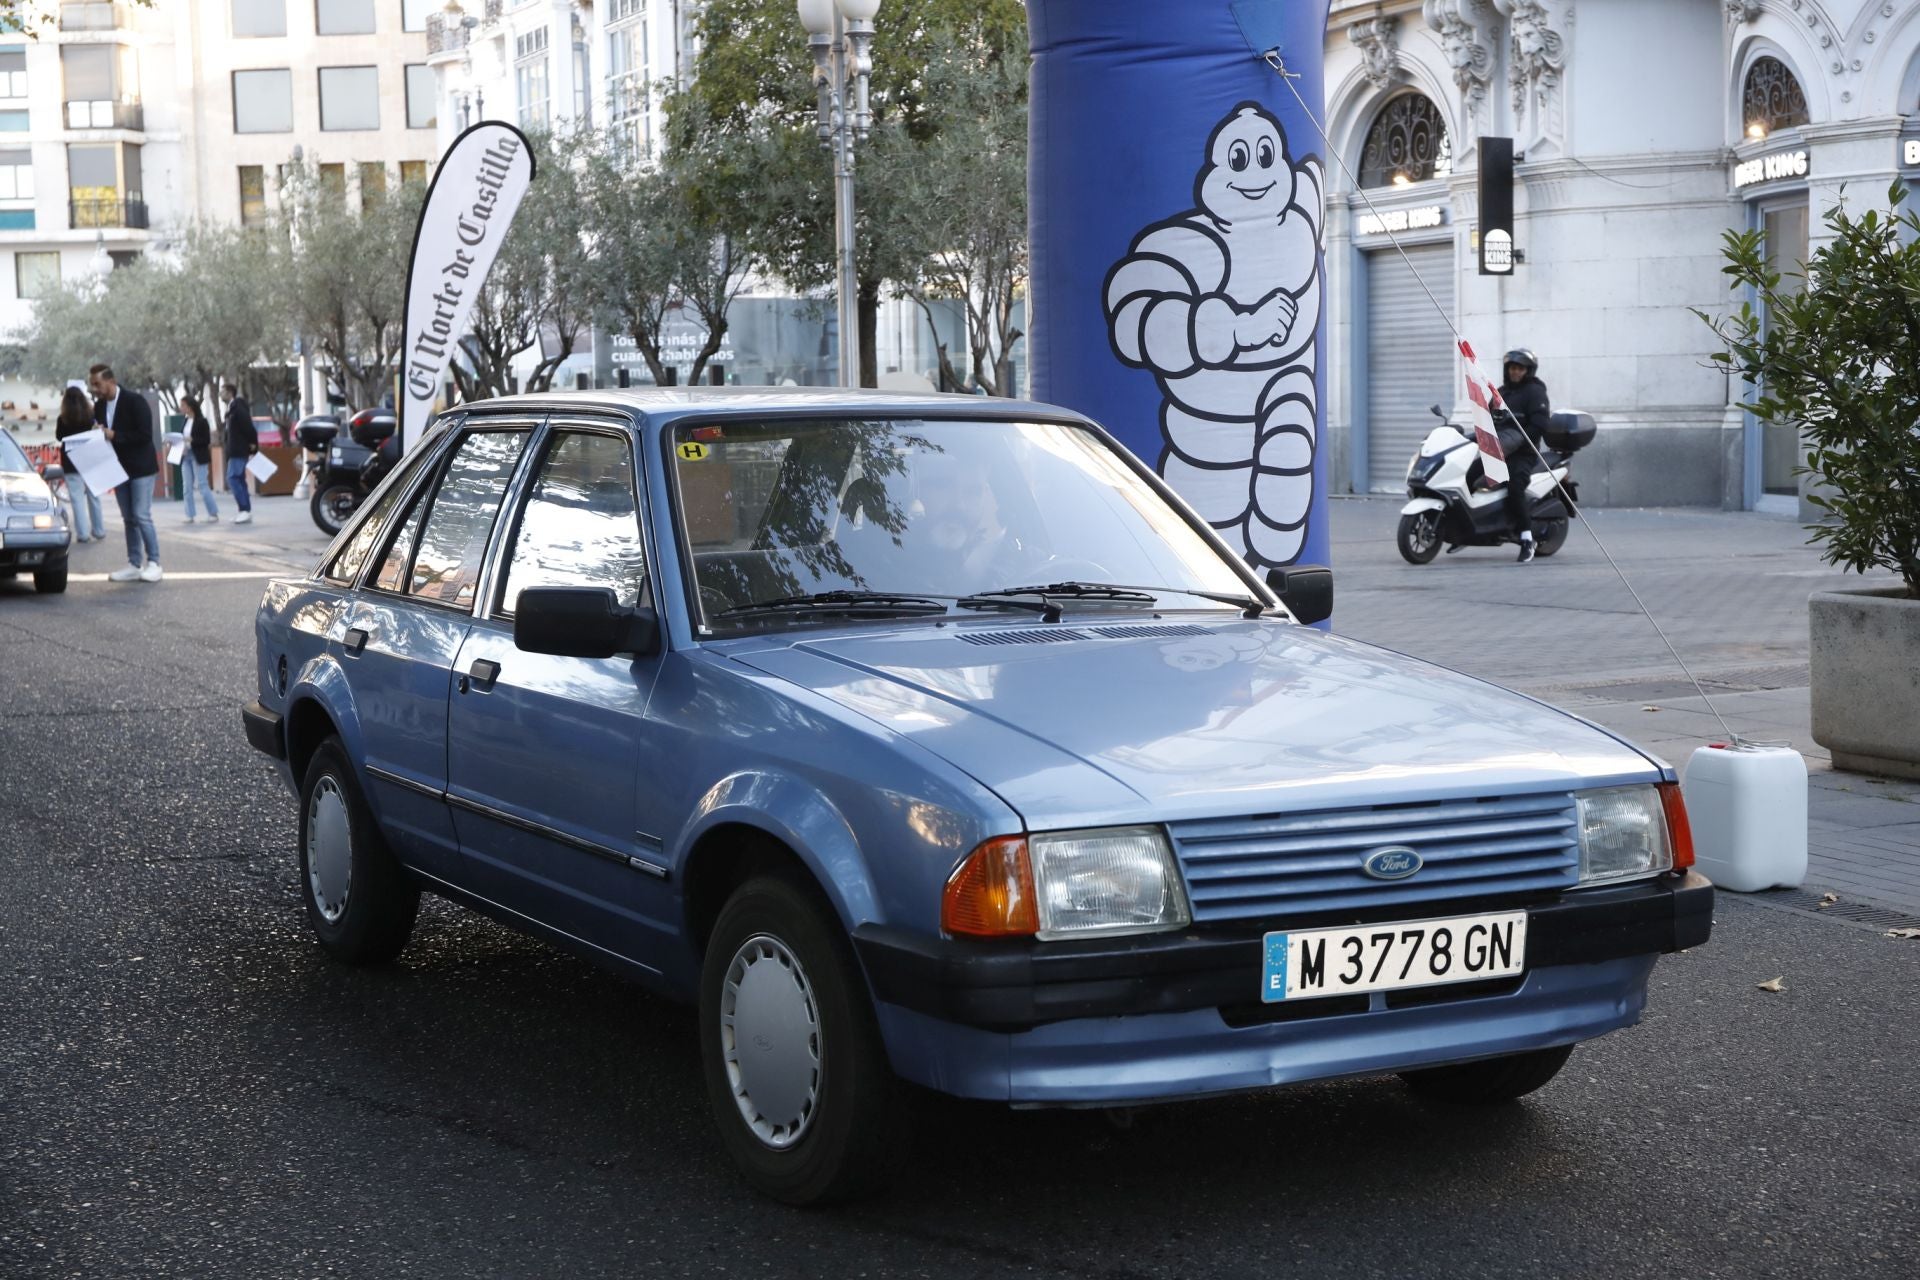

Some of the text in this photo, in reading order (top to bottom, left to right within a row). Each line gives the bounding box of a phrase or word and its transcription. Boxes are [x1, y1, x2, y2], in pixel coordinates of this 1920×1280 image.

[1765, 151, 1807, 179] KING
[457, 137, 520, 246] Castilla
[1409, 206, 1441, 228] KING
[442, 248, 475, 279] de
[1485, 251, 1512, 264] KING
[415, 282, 463, 358] Norte
[684, 445, 702, 458] H
[1380, 854, 1410, 871] Ford
[1300, 920, 1514, 989] M 3778 GN
[1270, 974, 1281, 989] E
